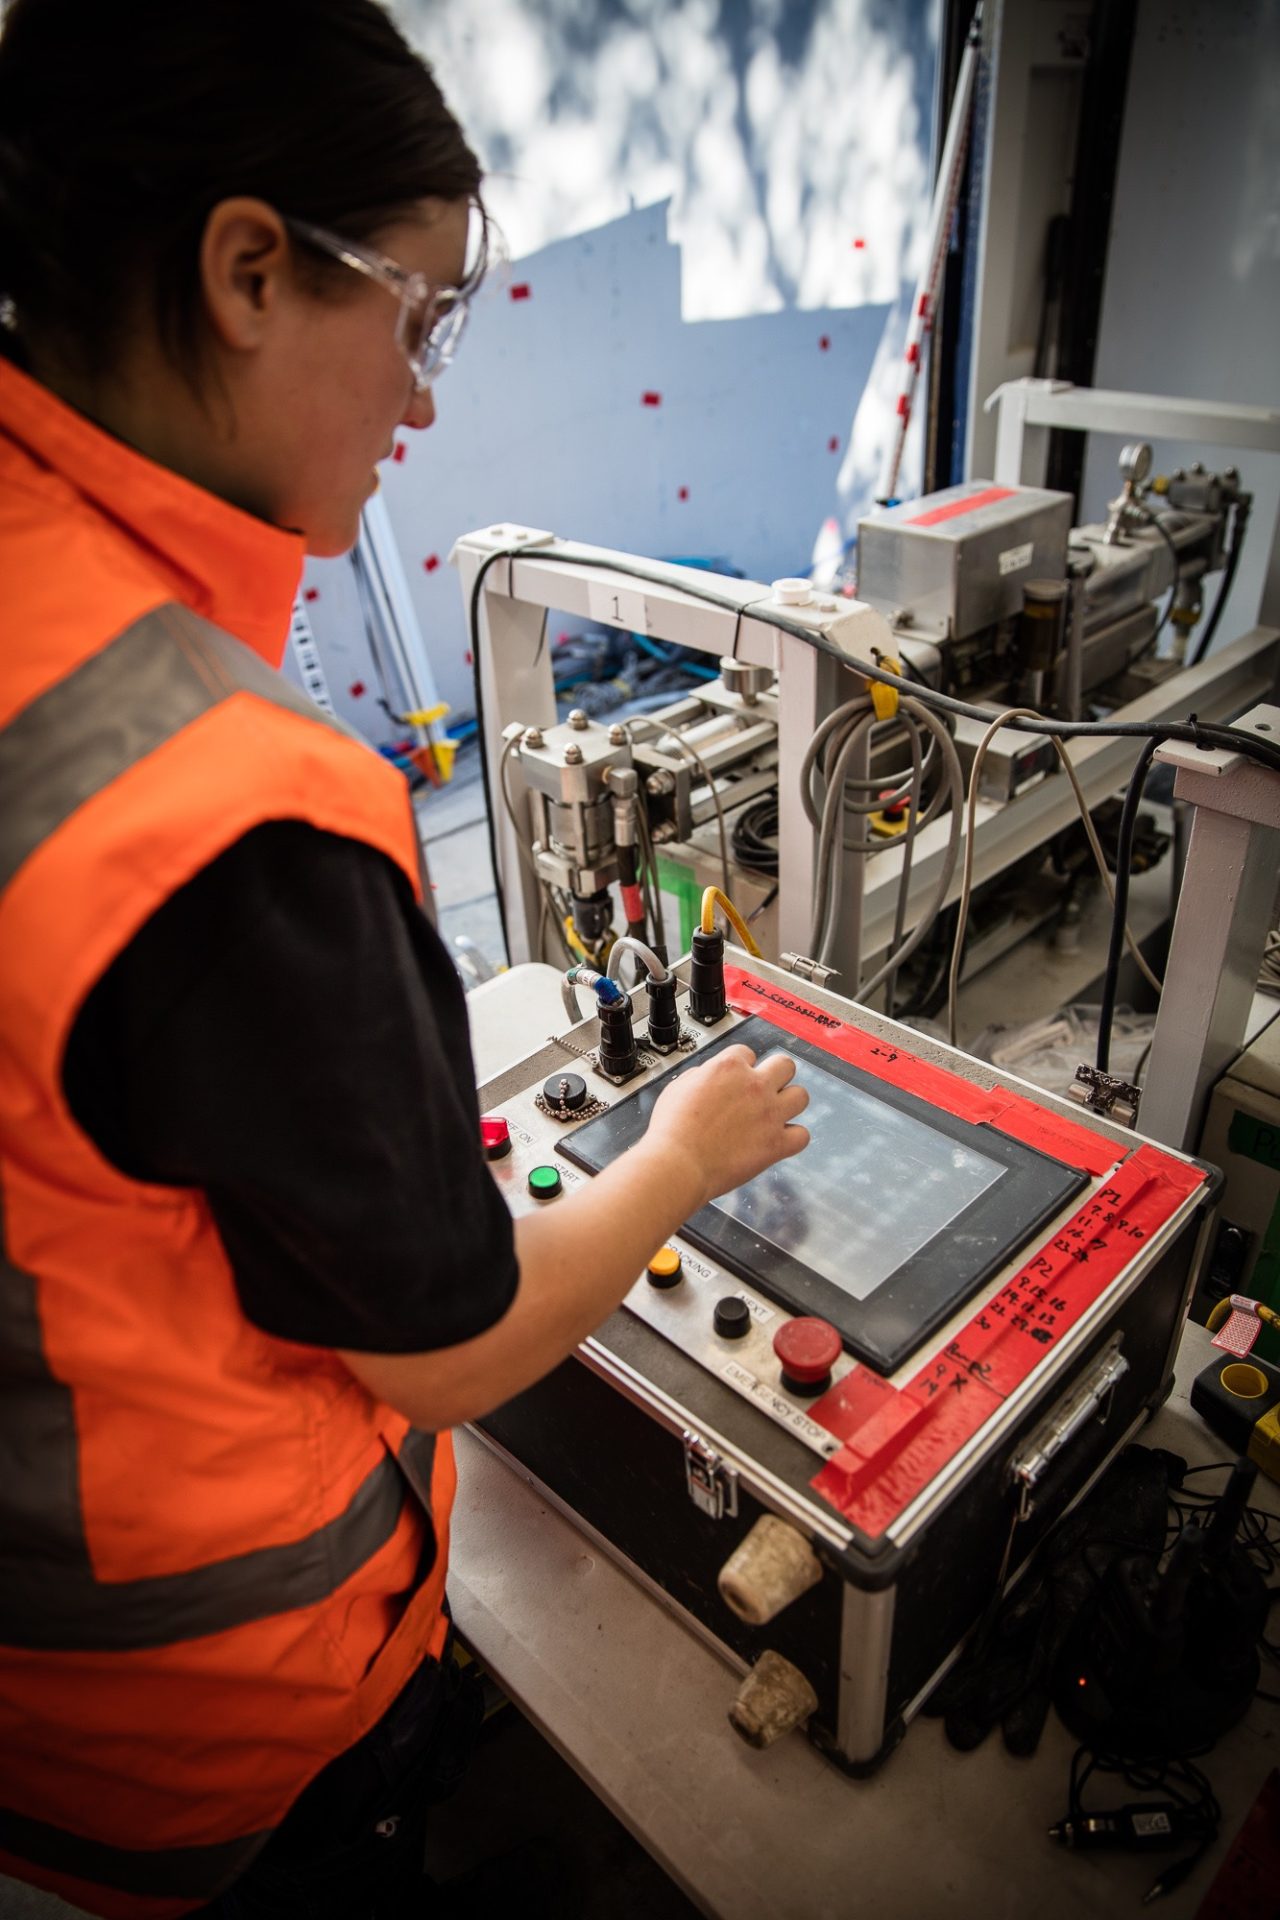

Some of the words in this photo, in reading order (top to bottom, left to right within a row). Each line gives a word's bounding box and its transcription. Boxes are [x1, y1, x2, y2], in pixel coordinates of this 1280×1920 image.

[611, 595, 624, 622] 1
[554, 1162, 580, 1183] START
[1099, 1188, 1121, 1207] P1
[1029, 1257, 1053, 1279] P2
[792, 1414, 827, 1439] STOP
